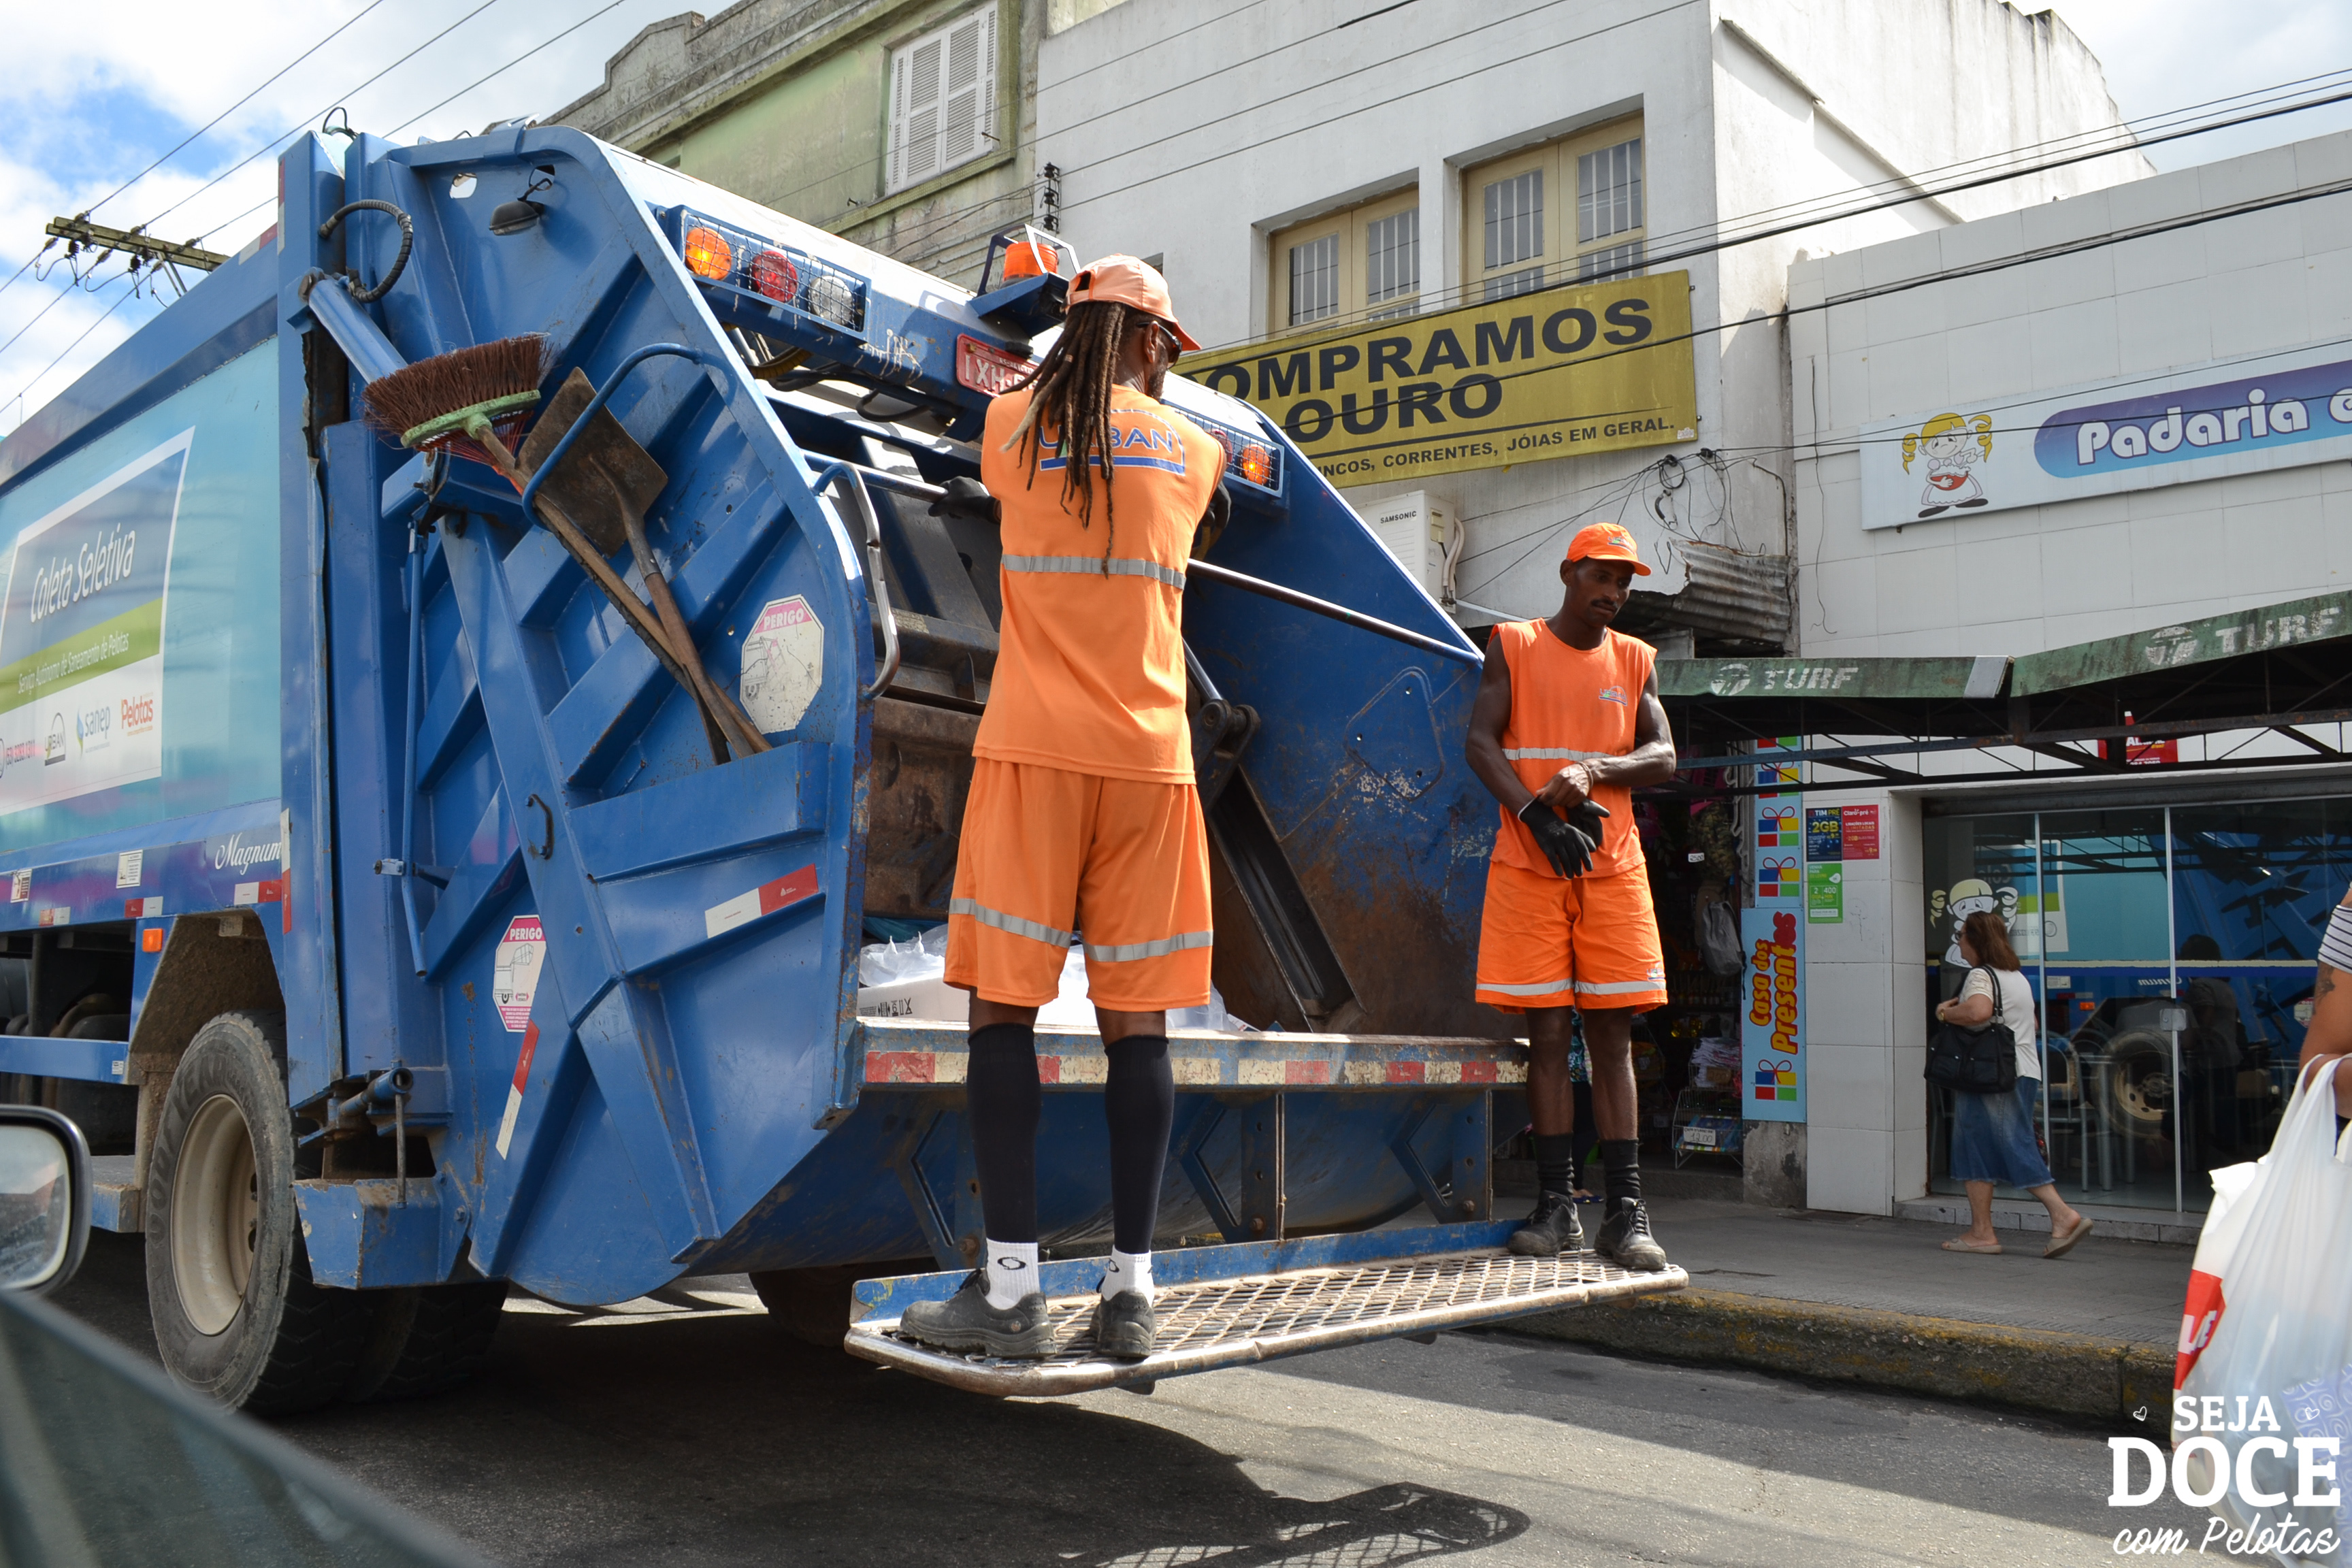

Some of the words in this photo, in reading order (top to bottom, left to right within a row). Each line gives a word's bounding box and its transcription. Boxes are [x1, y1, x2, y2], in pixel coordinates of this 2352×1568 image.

[1181, 298, 1652, 402] OMPRAMOS
[1284, 373, 1502, 443] OURO
[1383, 442, 1498, 468] CORRENTES,
[1507, 431, 1563, 451] JÓIAS
[1569, 426, 1597, 442] EM
[1603, 417, 1675, 437] GERAL.
[2076, 387, 2310, 466] Padaria
[1380, 510, 1417, 524] SAMSONIC
[31, 557, 74, 623] Coleta
[72, 522, 135, 602] Seletiva
[763, 608, 804, 631] PERIGO
[2215, 607, 2342, 653] TURF
[1764, 666, 1859, 690] TURF
[85, 706, 110, 740] sanep
[121, 696, 153, 730] Pelotas
[1812, 821, 1839, 833] 2GB
[1828, 808, 1840, 816] PRÉ
[215, 832, 282, 876] Magnum
[510, 927, 543, 941] PERIGO
[1751, 938, 1771, 972] dos
[1749, 972, 1772, 1026] Casa
